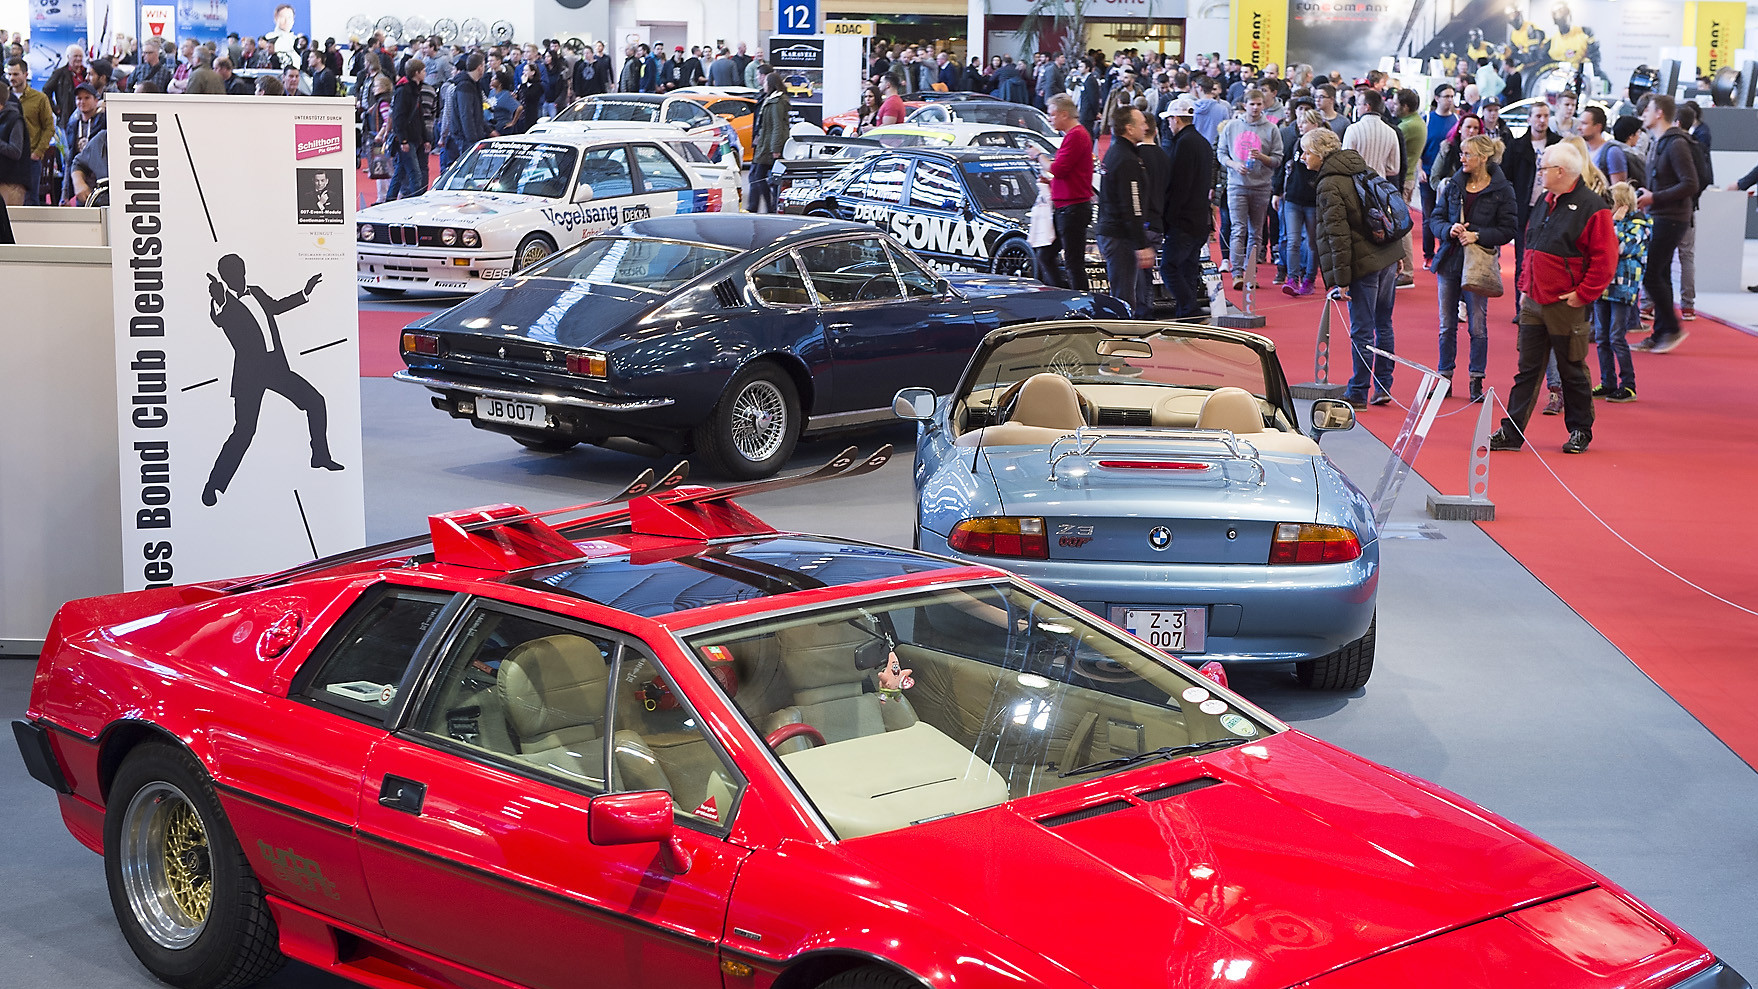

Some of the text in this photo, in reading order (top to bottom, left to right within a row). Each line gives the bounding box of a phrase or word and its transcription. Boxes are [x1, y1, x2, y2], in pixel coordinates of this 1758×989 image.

[146, 10, 168, 19] WIN
[783, 5, 811, 29] 12
[834, 24, 863, 35] ADAC
[297, 136, 340, 151] Schilthorn
[541, 205, 650, 232] Vogelsang DEKRA
[855, 203, 890, 221] DEKRA
[890, 210, 989, 258] SONAX
[121, 112, 174, 591] es Bond Club Deutschland
[487, 400, 535, 421] JB 007
[1058, 535, 1093, 548] 007
[1150, 631, 1183, 648] 007
[257, 838, 322, 882] turbo
